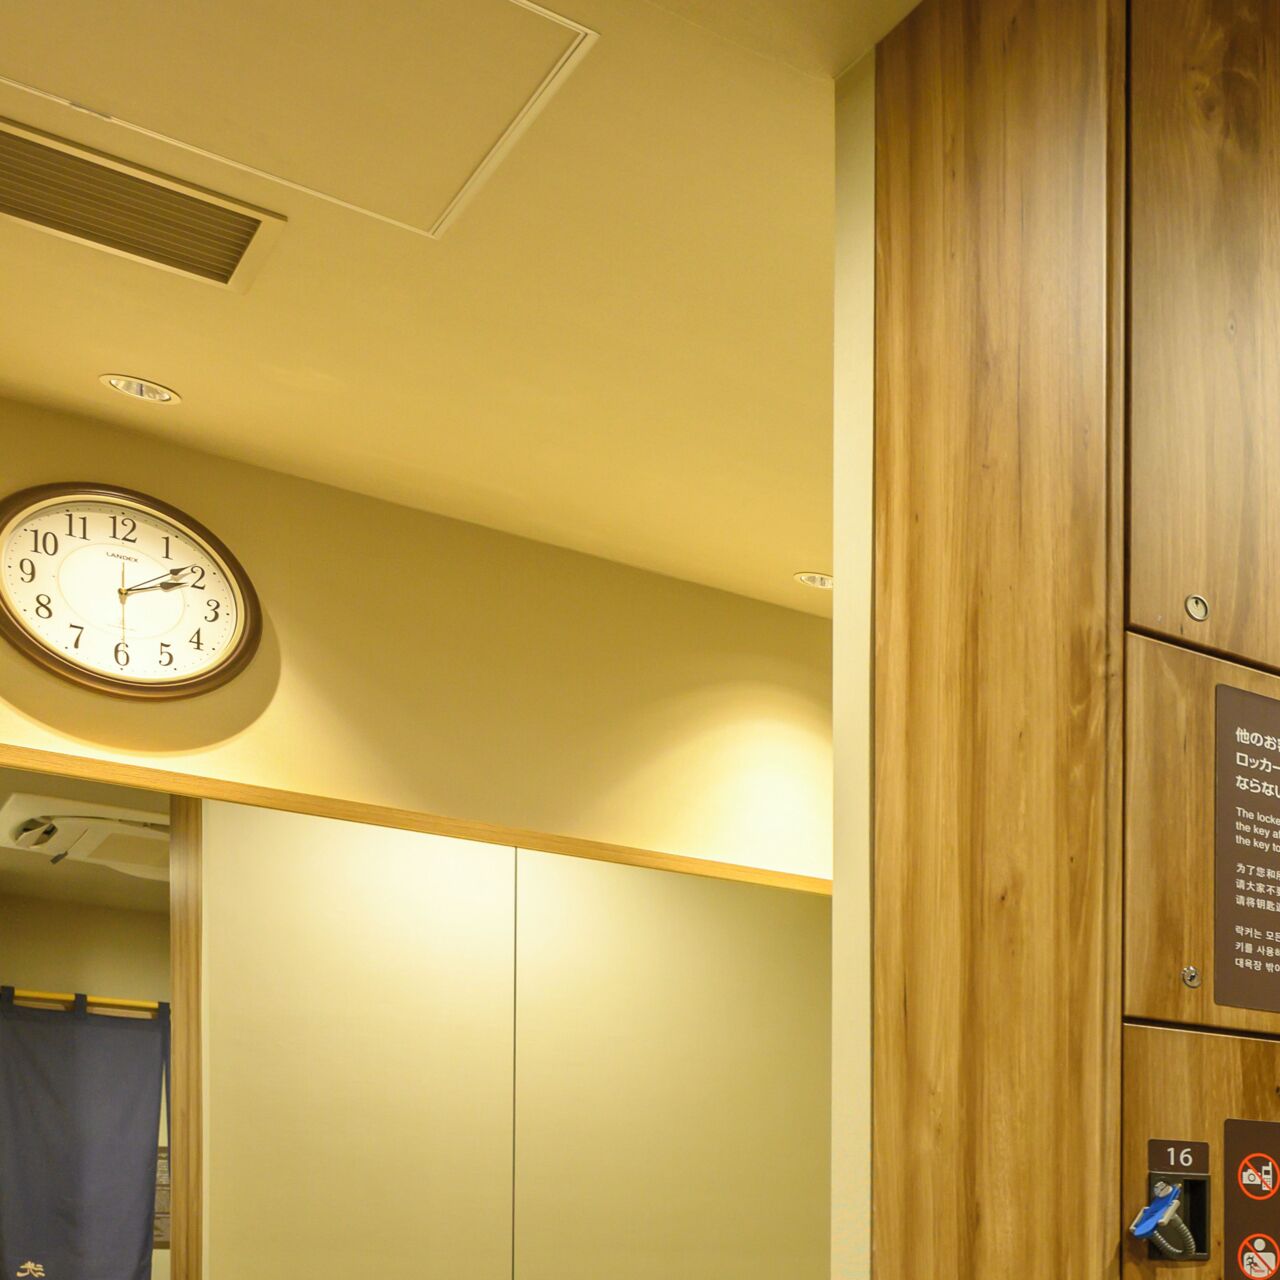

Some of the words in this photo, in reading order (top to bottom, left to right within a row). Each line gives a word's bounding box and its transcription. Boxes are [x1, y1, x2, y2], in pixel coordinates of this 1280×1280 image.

[64, 514, 90, 540] 11
[109, 516, 138, 543] 12
[30, 529, 58, 556] 10
[162, 536, 174, 560] 1
[106, 552, 138, 562] LANDEX
[20, 558, 36, 583] 9
[190, 566, 206, 590] 2
[35, 594, 52, 619] 8
[204, 599, 220, 622] 3
[69, 623, 84, 648] 7
[189, 628, 204, 650] 4
[114, 642, 130, 666] 6
[158, 643, 174, 666] 5
[1235, 806, 1254, 820] The
[1235, 821, 1251, 833] the
[1253, 824, 1270, 839] key
[1167, 1147, 1193, 1167] 16
